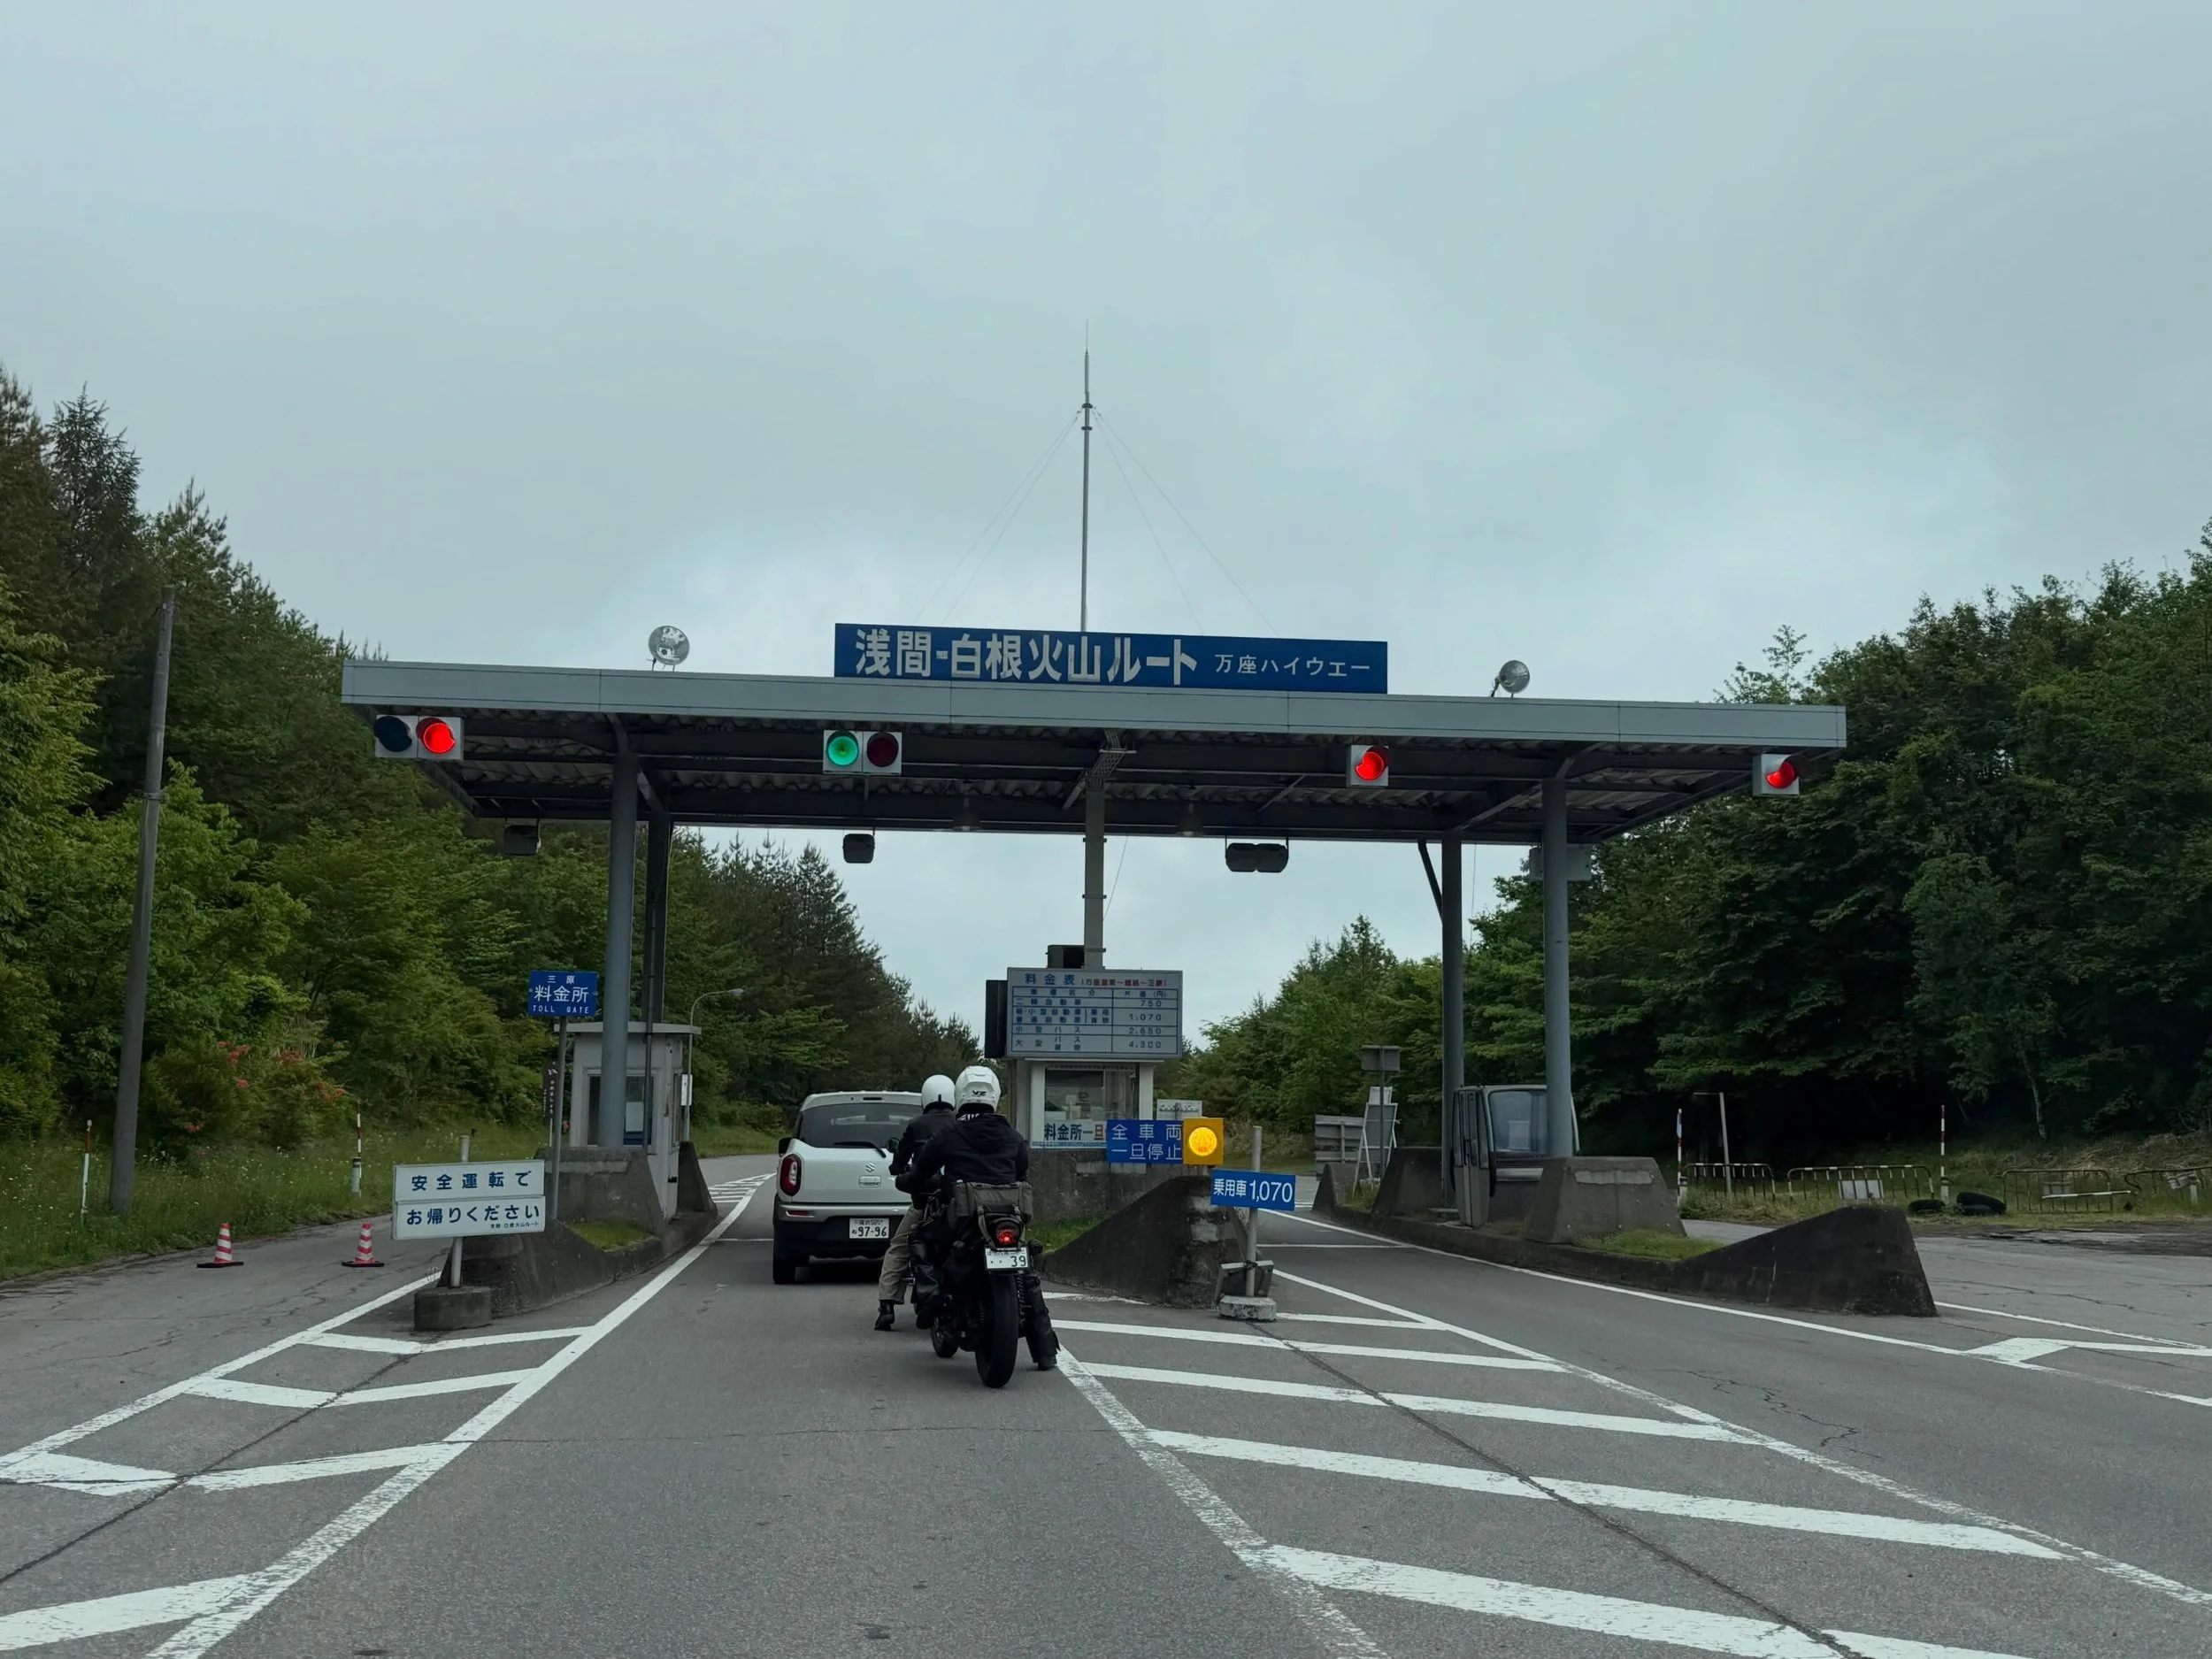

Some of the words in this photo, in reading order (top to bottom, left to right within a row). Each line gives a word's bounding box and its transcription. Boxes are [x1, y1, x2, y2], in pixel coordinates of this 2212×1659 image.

[1025, 973, 1076, 986] 料金表
[534, 985, 589, 1003] 料金所
[532, 1004, 555, 1013] TOLL
[1044, 1123, 1104, 1141] 料金所一旦
[1111, 1124, 1182, 1141] 全車両
[1111, 1142, 1182, 1160] 一旦停止
[411, 1171, 533, 1192] 安全運転で
[1213, 1178, 1248, 1198] 乗用車
[1248, 1179, 1294, 1203] 1,070
[406, 1204, 540, 1225] お帰りください
[857, 1226, 887, 1237] 97-96
[1010, 1255, 1026, 1267] 39
